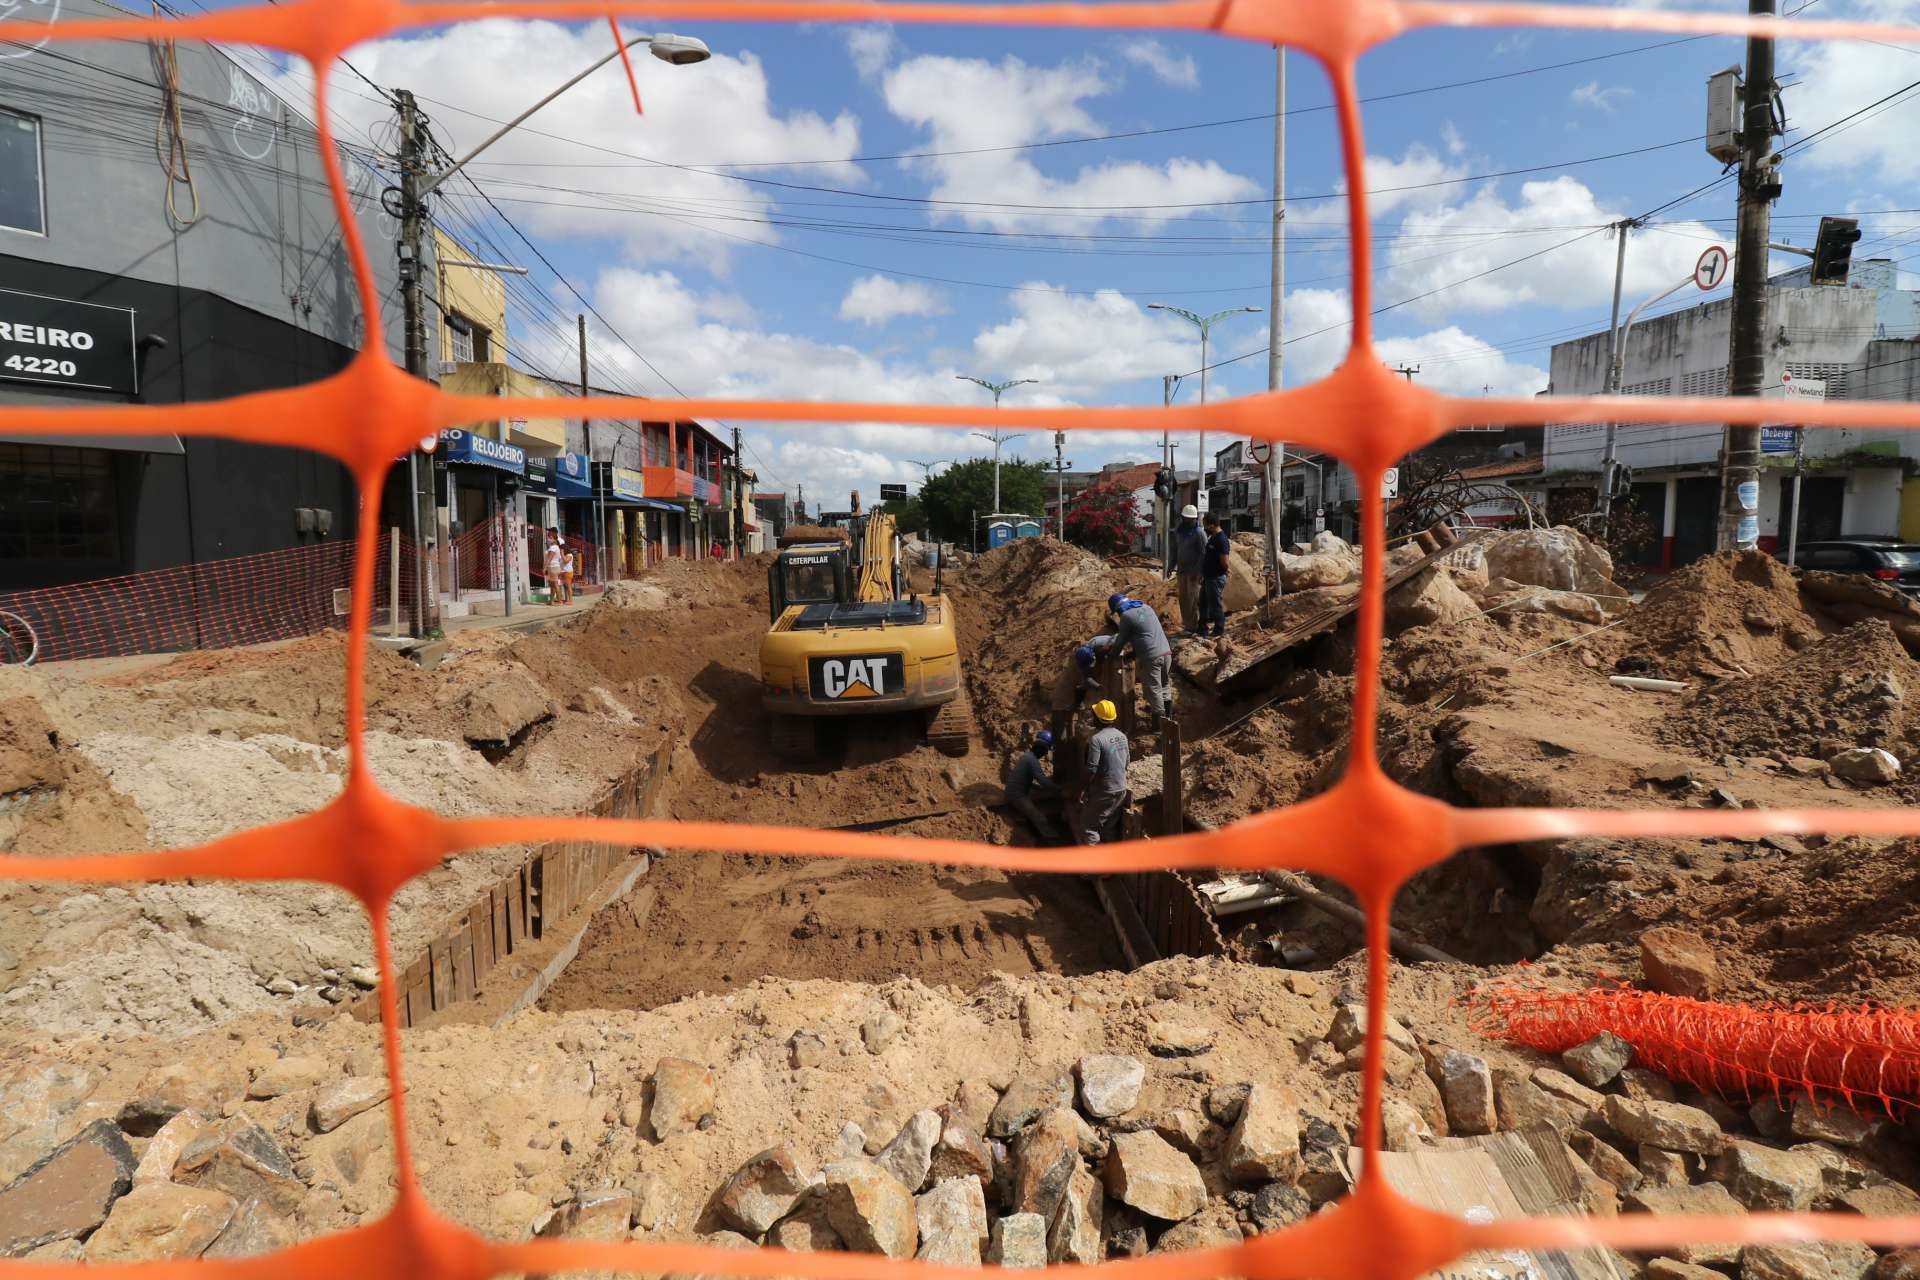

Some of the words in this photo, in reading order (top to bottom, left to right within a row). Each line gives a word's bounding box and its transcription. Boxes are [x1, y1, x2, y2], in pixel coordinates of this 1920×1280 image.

[0, 322, 94, 350] REIRO
[4, 354, 77, 376] 4220
[1798, 386, 1824, 398] Newland
[472, 436, 524, 463] RELOJOEIRO
[788, 556, 829, 565] CATERPILLAR
[822, 658, 888, 698] CAT
